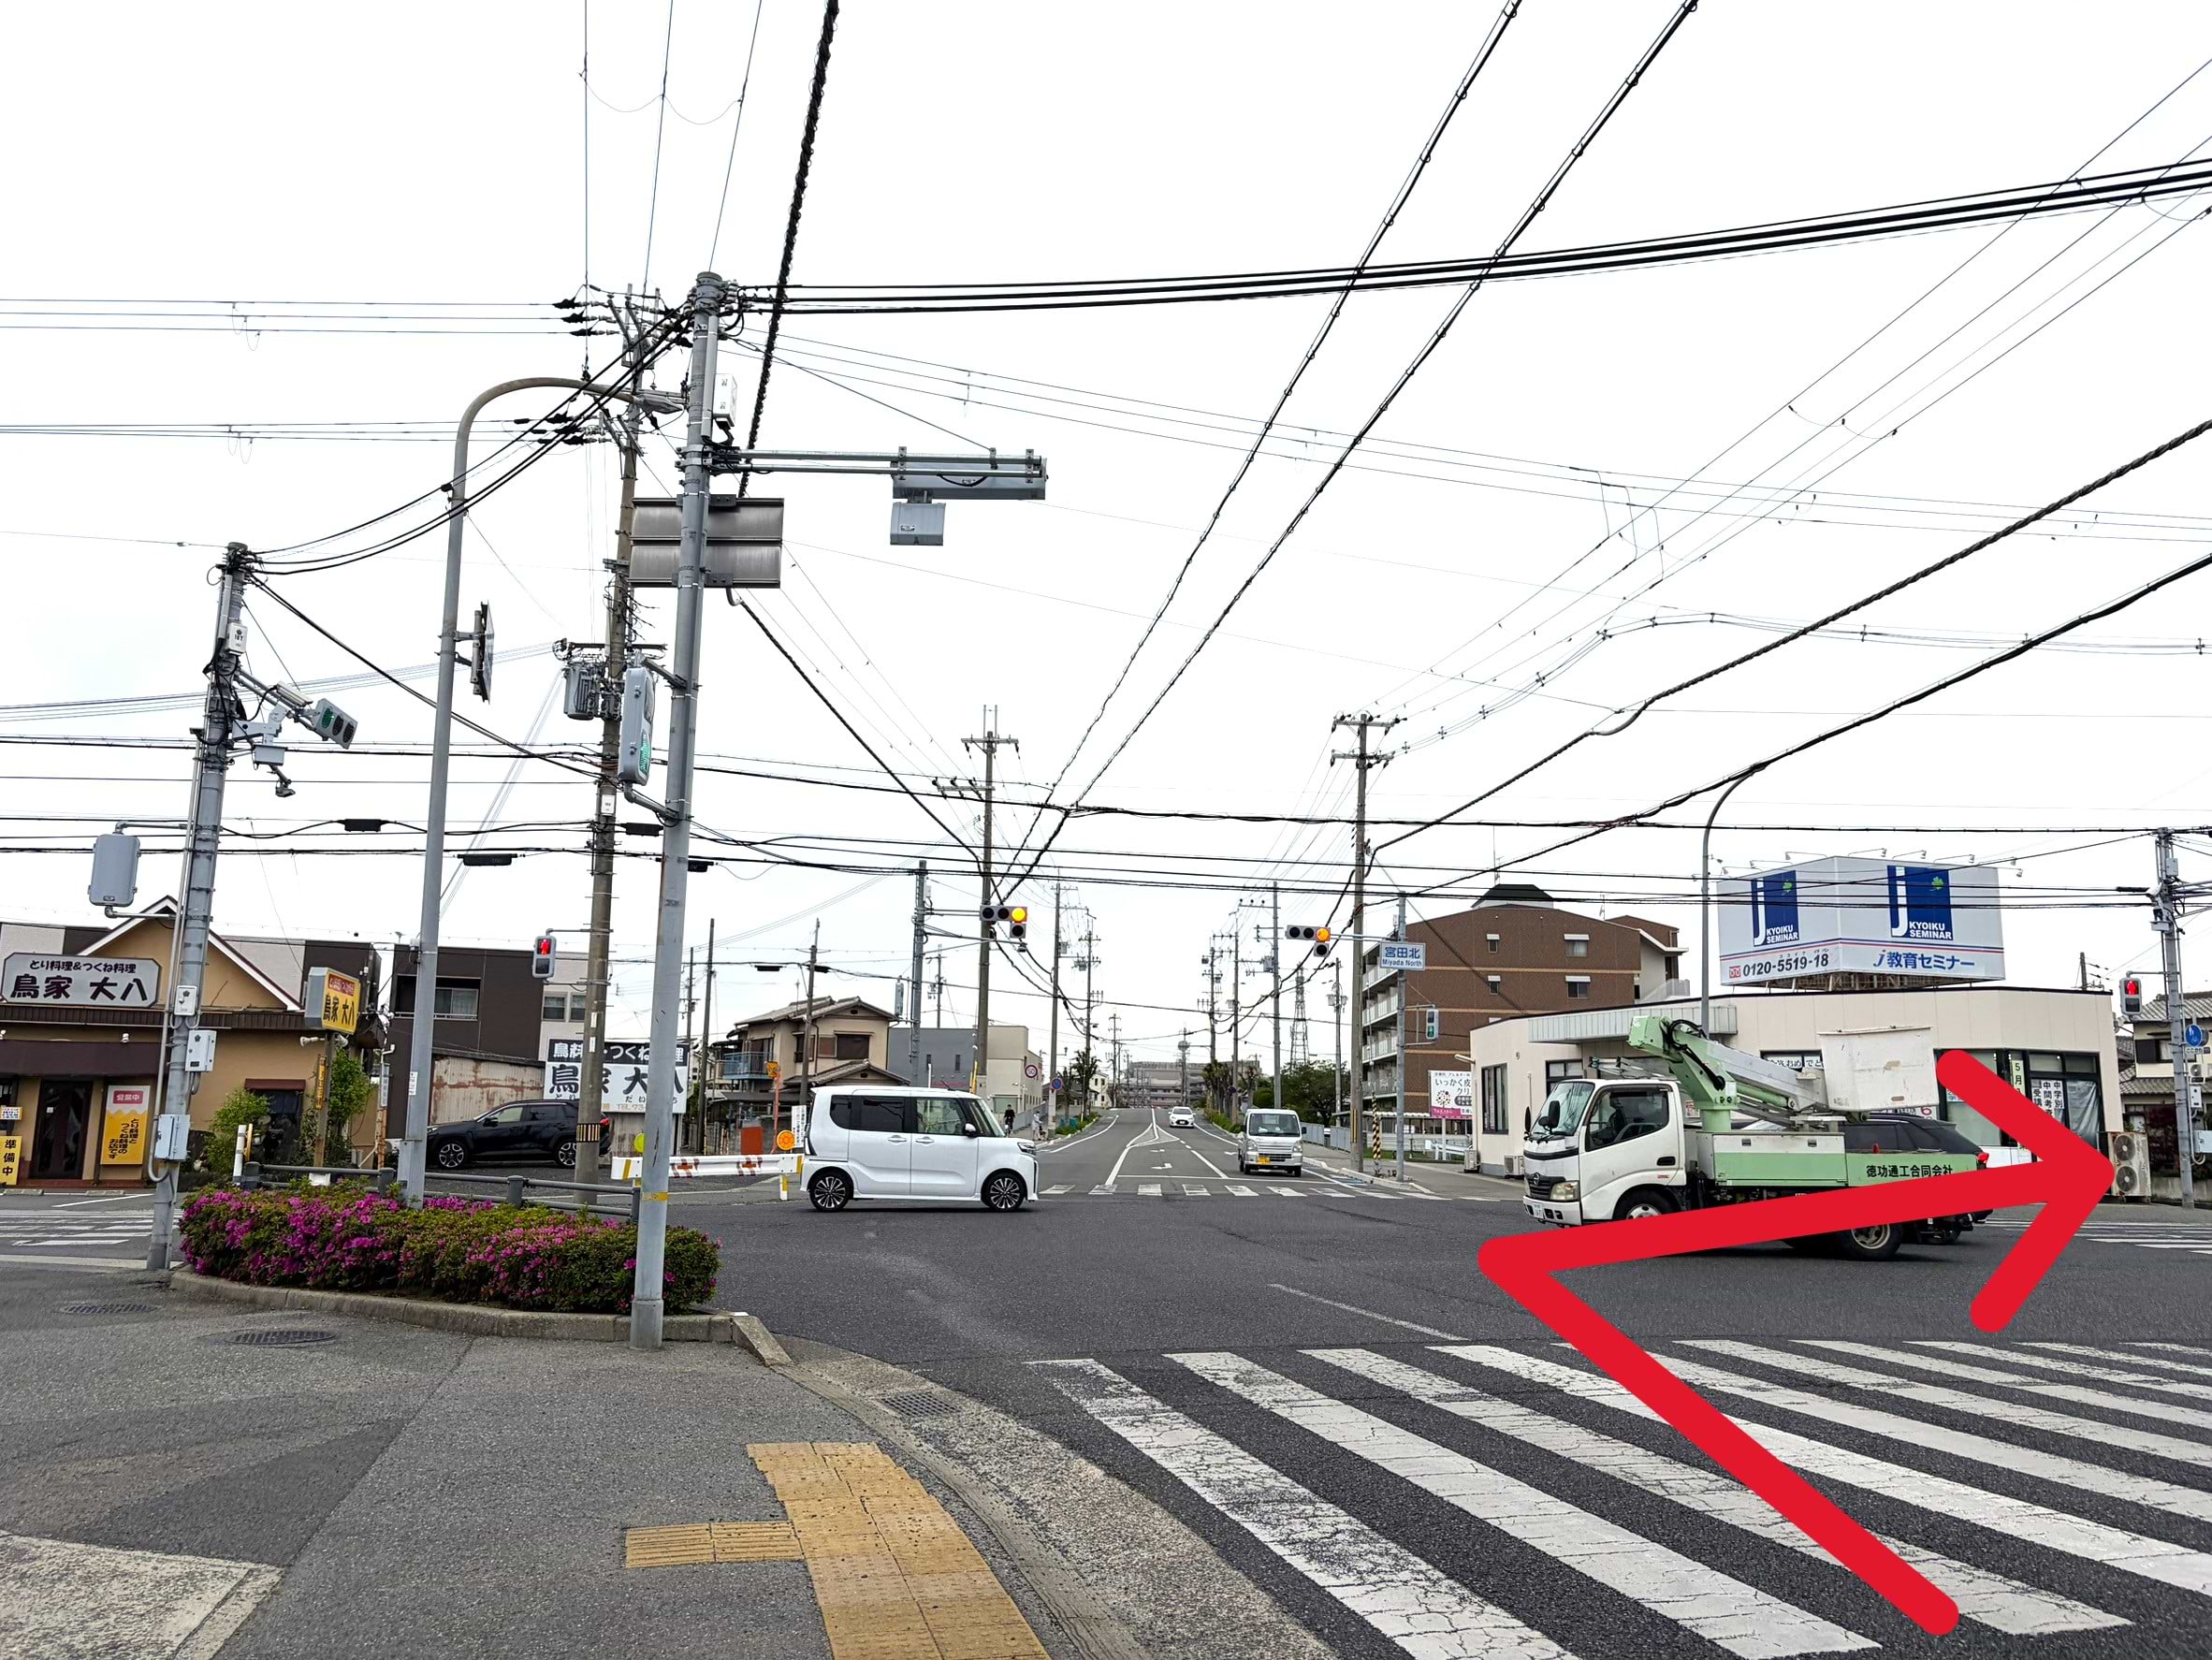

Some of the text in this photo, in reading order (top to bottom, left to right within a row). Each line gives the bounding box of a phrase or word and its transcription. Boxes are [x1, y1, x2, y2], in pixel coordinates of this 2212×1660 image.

[1766, 924, 1794, 937] KYOIKU
[1909, 921, 1945, 931] KYOIKU
[1767, 932, 1798, 944] SEMINAR
[1909, 929, 1952, 940] SEMINAR
[1385, 946, 1420, 959] 宮田北
[1382, 958, 1404, 967] Miyada
[1742, 954, 1829, 977] 0120-5519-18
[10, 973, 148, 1002] 鳥家 大八
[323, 993, 355, 1027] 鳥家 大八
[2053, 1081, 2063, 1109] 中学別
[2, 1139, 17, 1176] 準備中
[1866, 1164, 1954, 1178] 徳功通工合同会社
